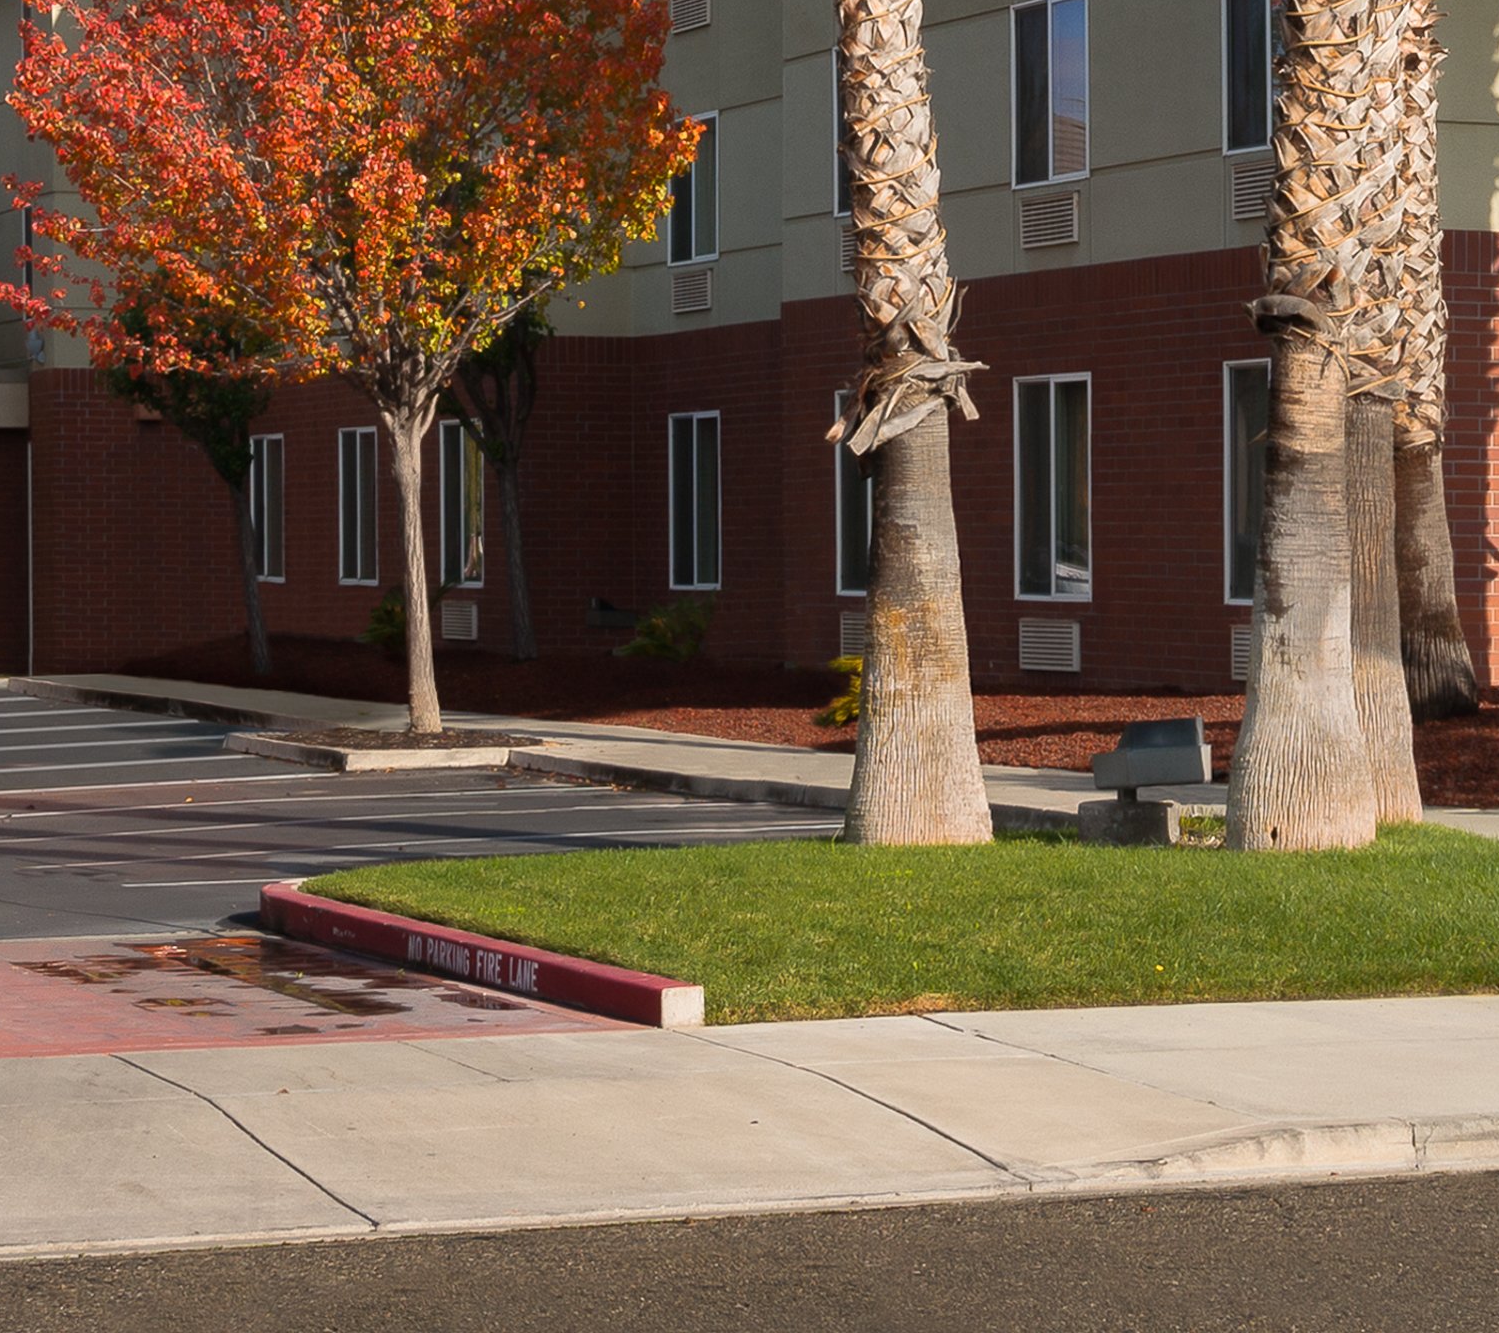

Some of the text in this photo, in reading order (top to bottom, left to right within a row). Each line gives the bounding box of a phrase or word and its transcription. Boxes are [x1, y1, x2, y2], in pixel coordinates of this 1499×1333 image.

[407, 935, 540, 992] NO PARKING FIRE LANE
